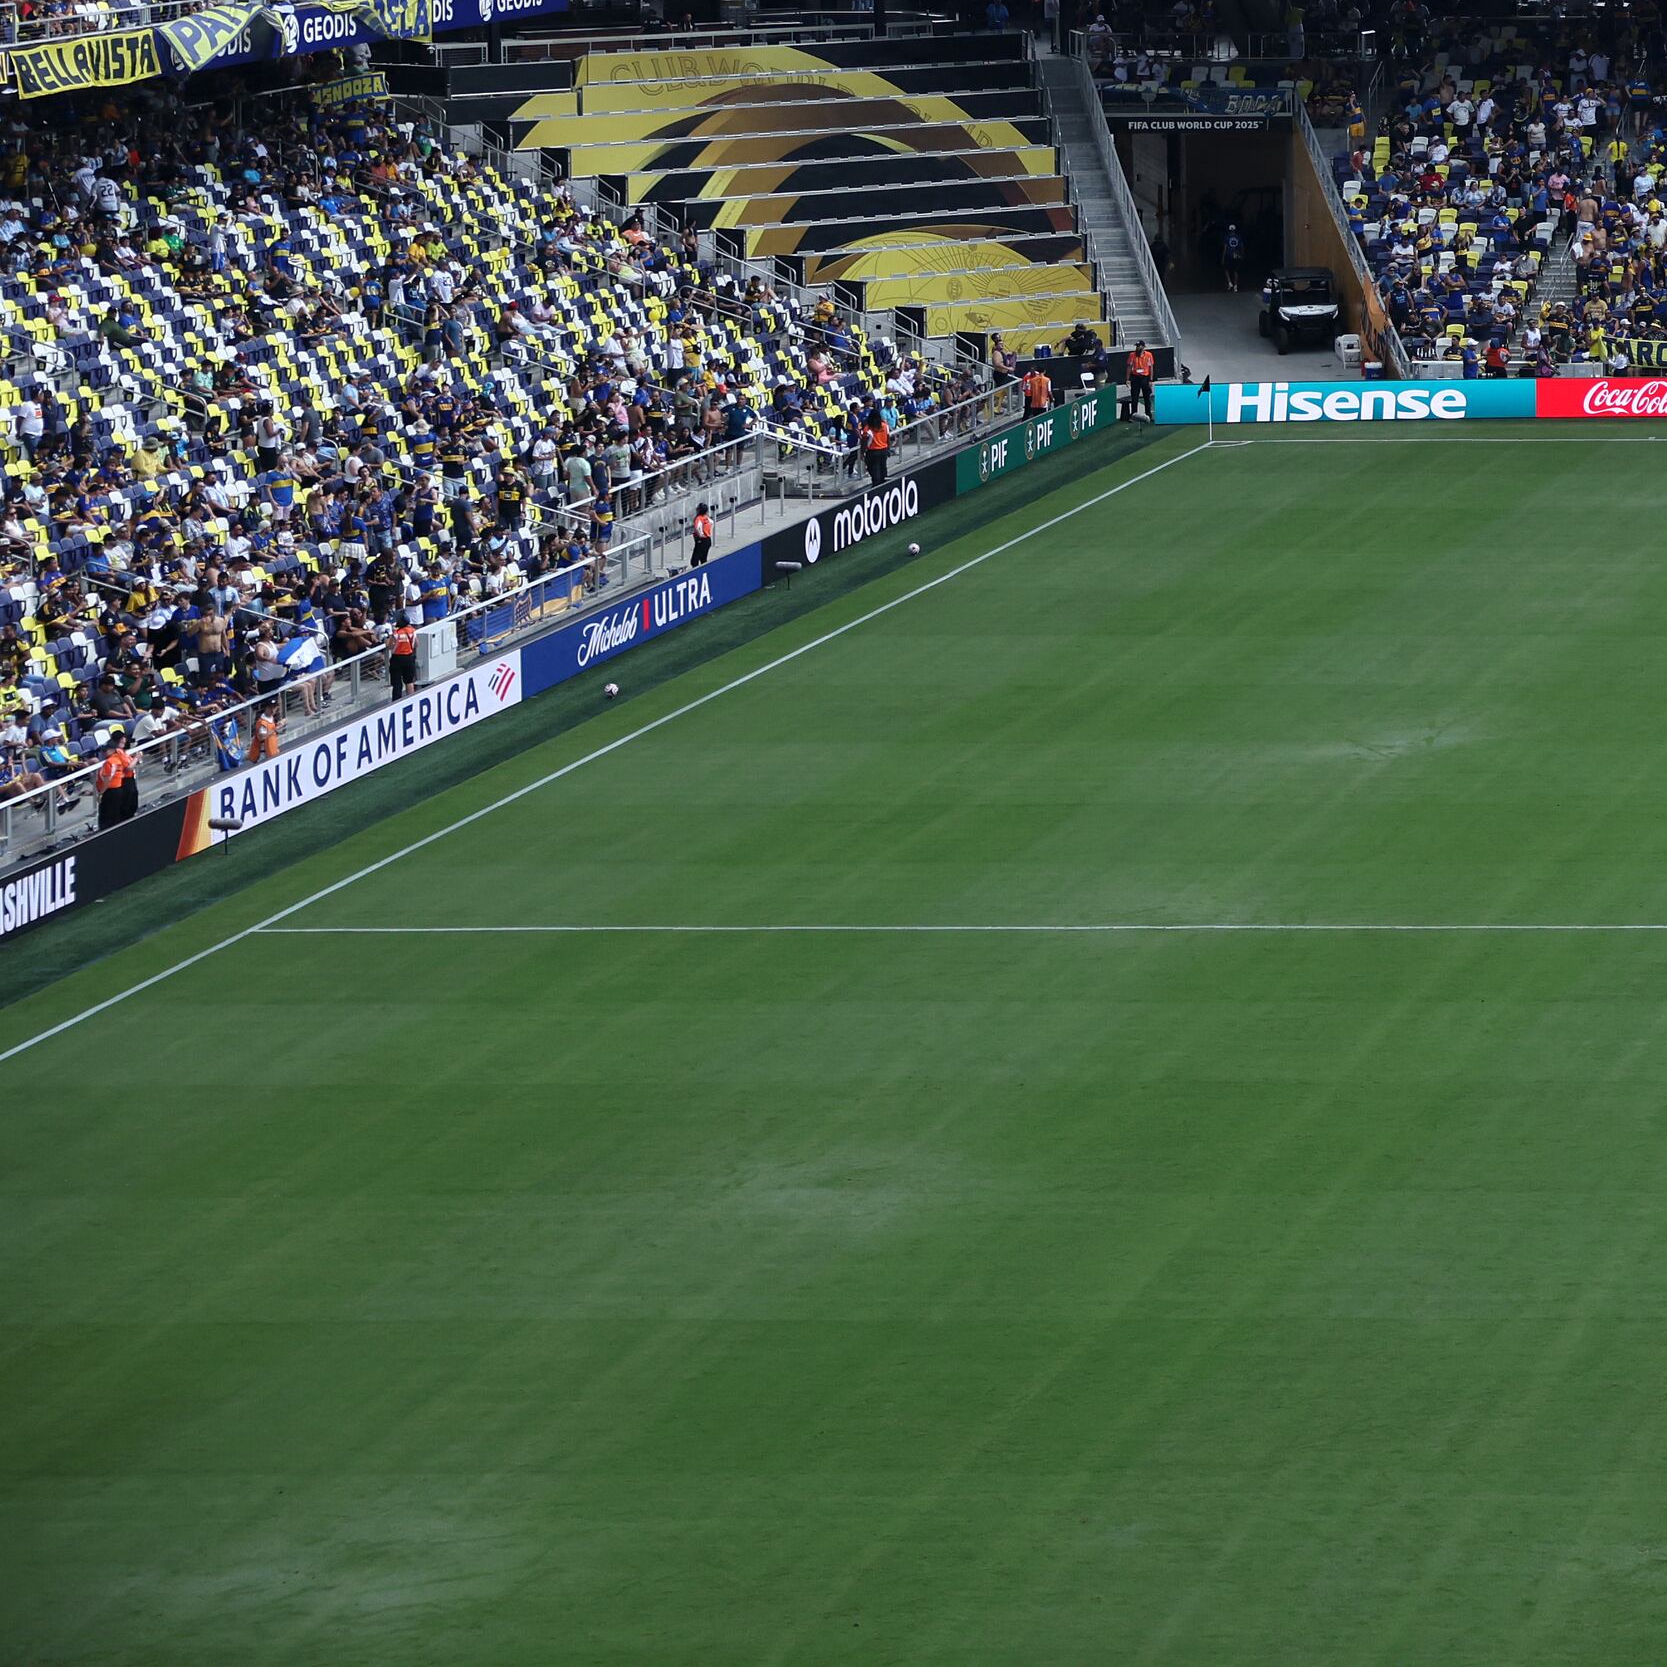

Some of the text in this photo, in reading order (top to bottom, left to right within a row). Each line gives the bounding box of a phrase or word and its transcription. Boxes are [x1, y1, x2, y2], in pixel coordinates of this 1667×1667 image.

[304, 13, 357, 43] GEODIS
[611, 55, 708, 96] CLUB
[1128, 121, 1258, 130] FIFA CLUB WORLD CUP 2025
[1081, 398, 1098, 429] PIF
[1227, 382, 1467, 423] Hisense
[1036, 418, 1055, 450] PIF
[991, 438, 1009, 471] PIF
[833, 477, 919, 552] motorola
[576, 572, 712, 668] Michelob ULTRA
[222, 676, 479, 824] BANK OF AMERICA
